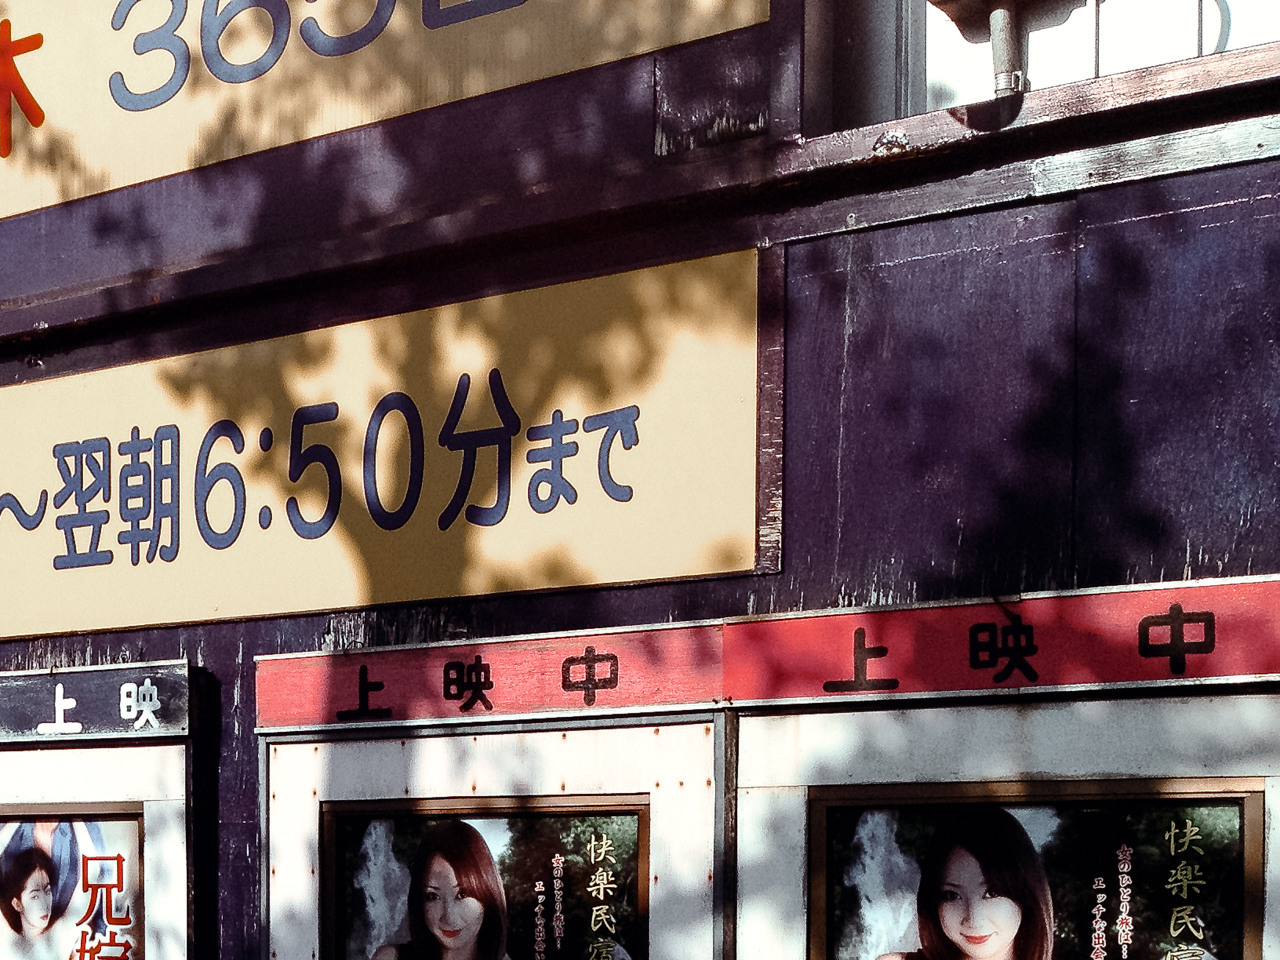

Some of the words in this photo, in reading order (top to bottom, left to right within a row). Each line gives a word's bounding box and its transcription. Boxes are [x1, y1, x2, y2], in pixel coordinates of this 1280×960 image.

[335, 644, 620, 721] 上映中
[822, 602, 1216, 693] 上映中
